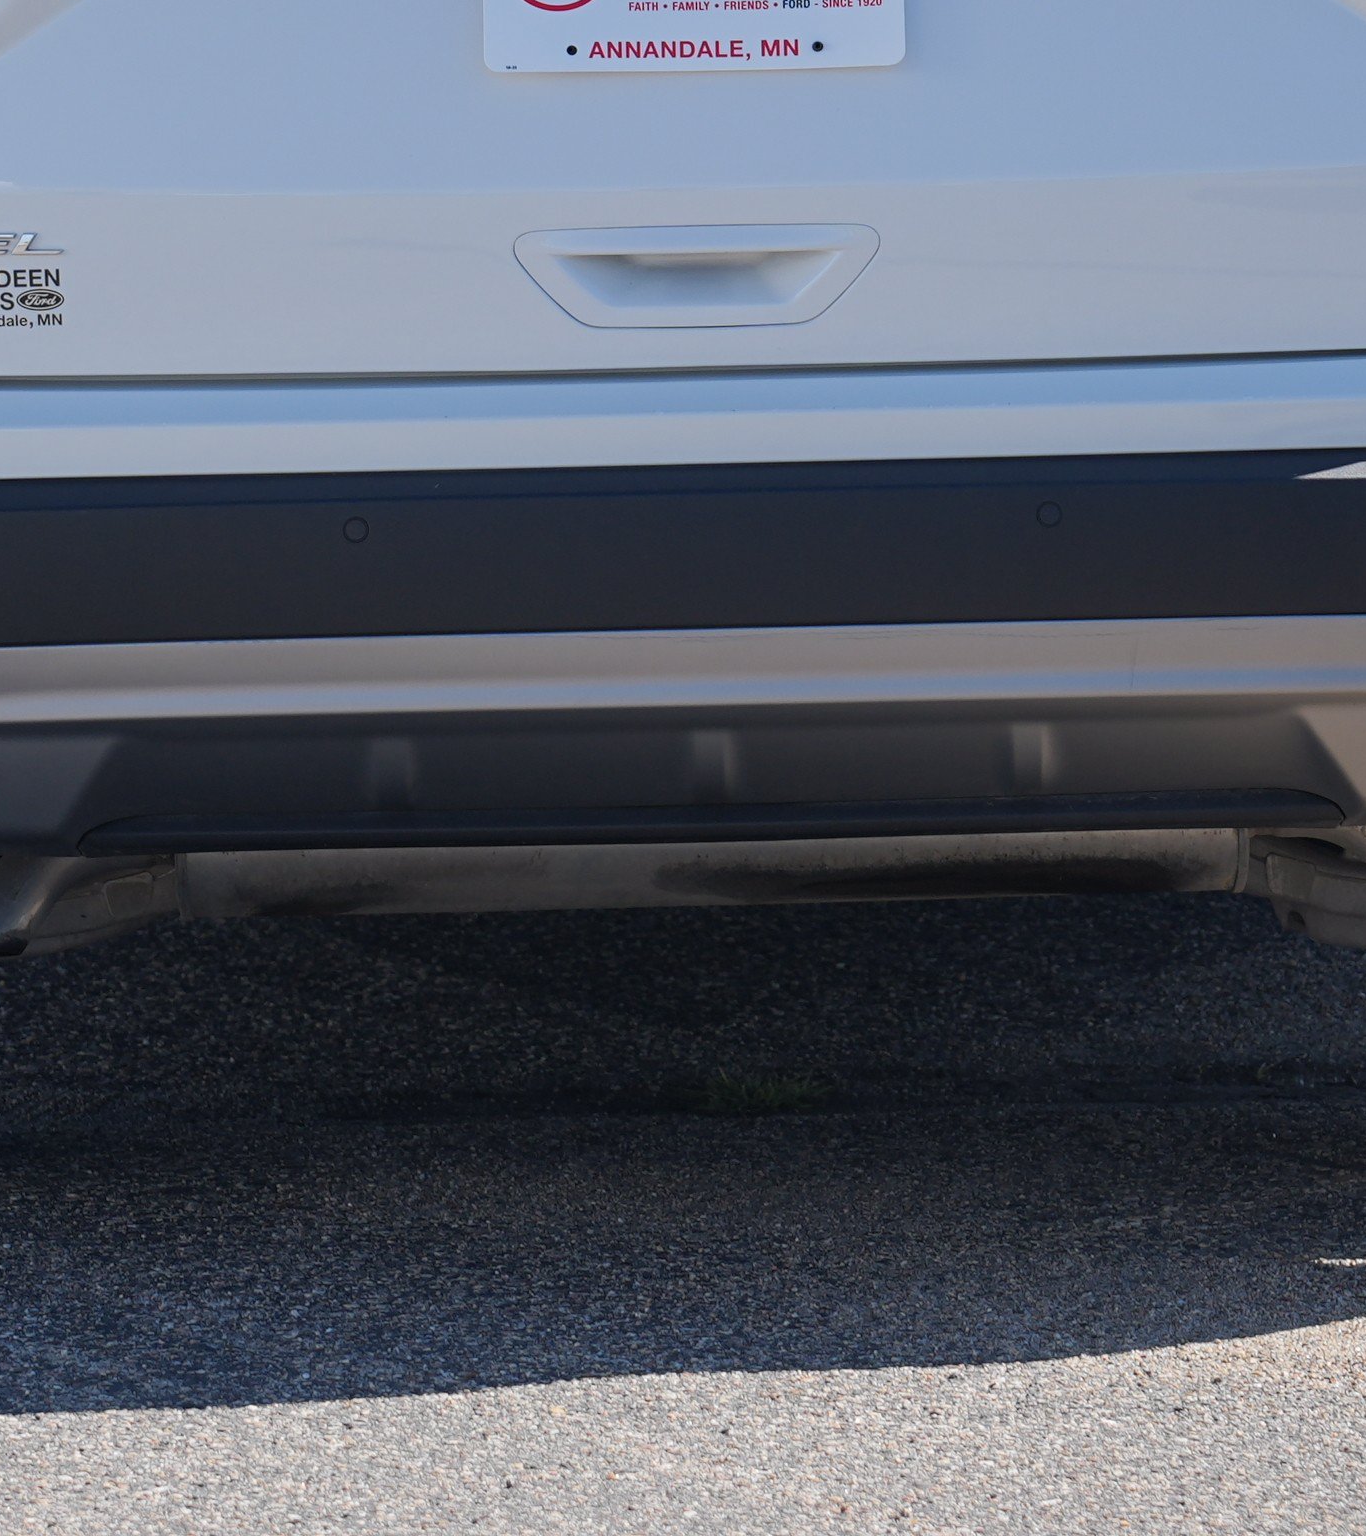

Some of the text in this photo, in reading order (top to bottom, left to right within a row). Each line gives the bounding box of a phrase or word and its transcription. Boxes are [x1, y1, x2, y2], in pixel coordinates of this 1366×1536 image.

[628, 1, 659, 11] FAITH
[672, 1, 710, 11] FAMILY
[723, 0, 770, 10] FRIENDS
[782, 0, 811, 9] FORD
[588, 39, 800, 61] ANNANDALE, MN
[37, 314, 63, 326] MN
